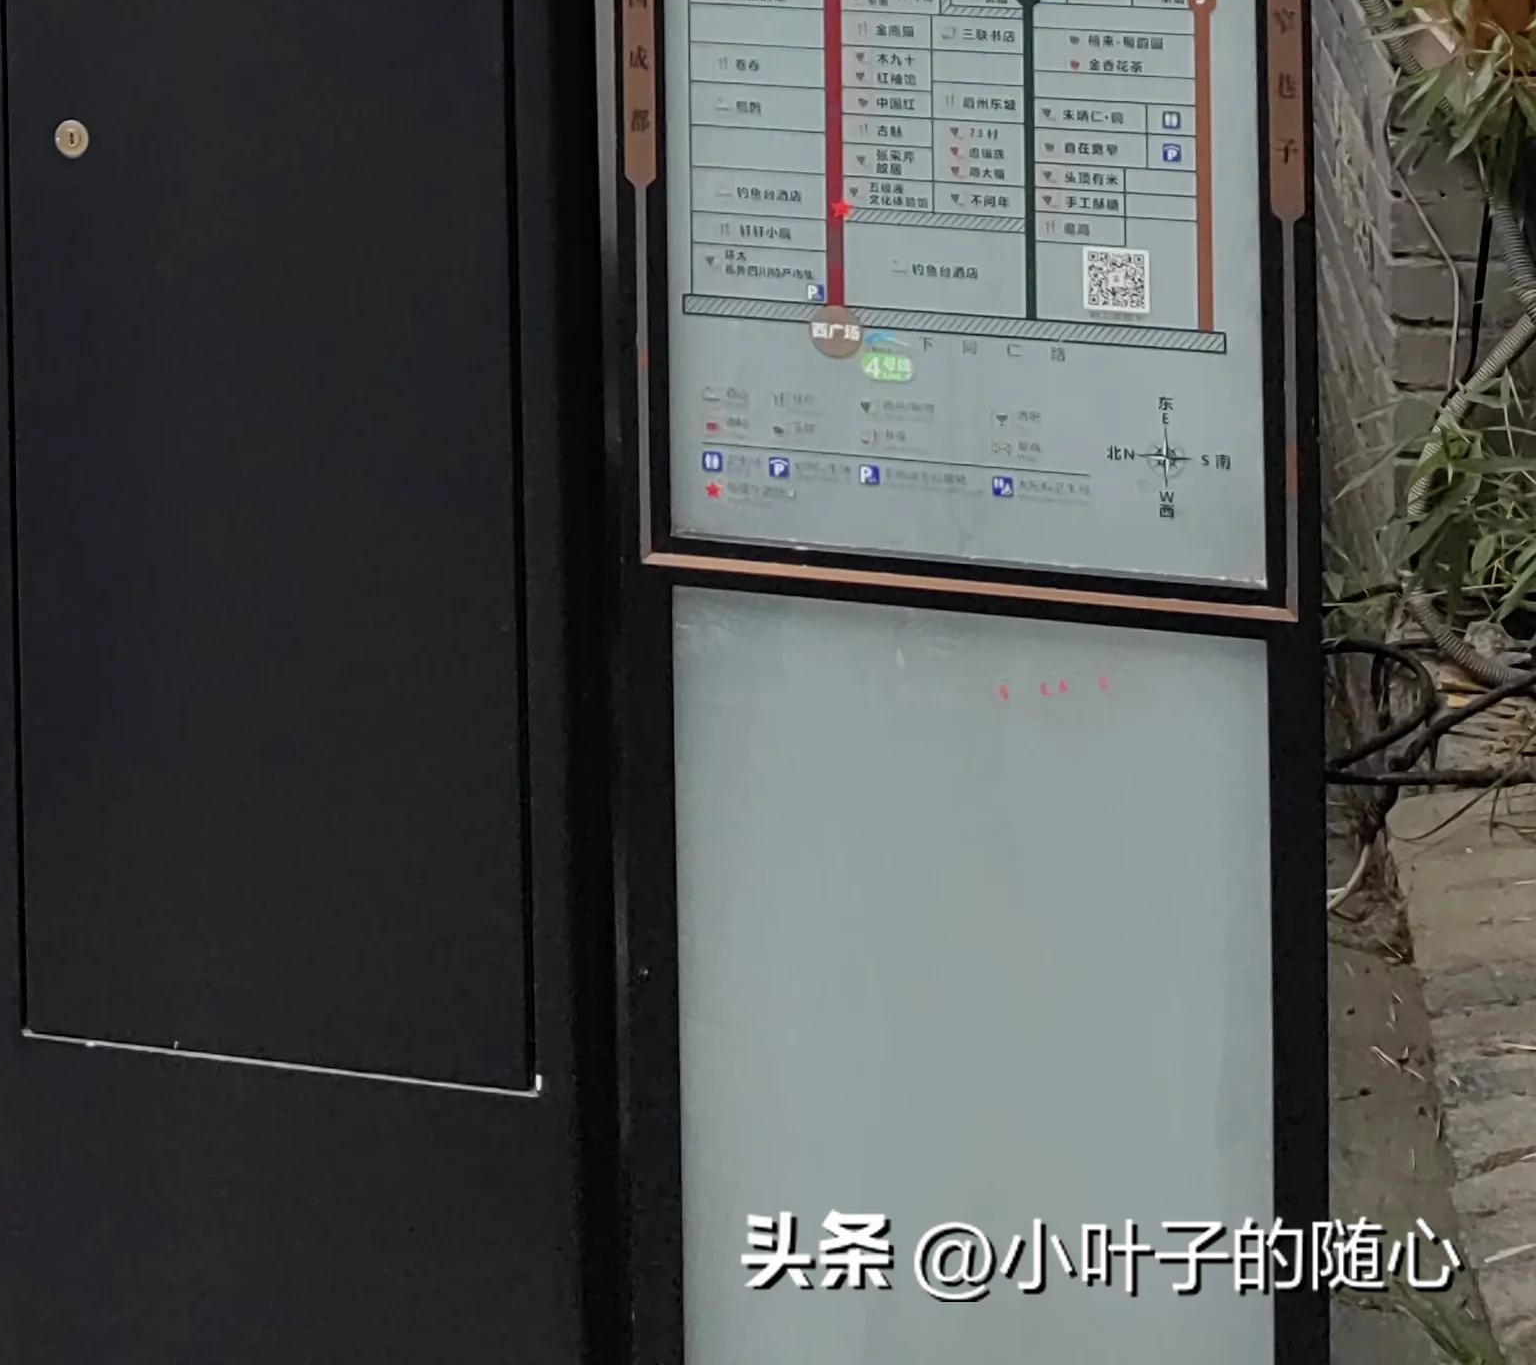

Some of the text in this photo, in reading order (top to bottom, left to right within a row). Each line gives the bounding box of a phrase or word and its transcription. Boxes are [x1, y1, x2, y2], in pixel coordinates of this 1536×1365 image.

[963, 28, 1015, 42] 三联书店
[877, 53, 915, 66] 木九十
[876, 98, 915, 110] 中国红
[737, 186, 802, 202] 钓鱼台酒店
[912, 264, 978, 279] 钓鱼台酒店
[811, 322, 859, 341] 西广场
[1159, 397, 1173, 410] 东
[1162, 413, 1169, 424] E
[1107, 446, 1121, 460] 北
[1123, 448, 1135, 460] N
[1216, 454, 1231, 469] 南
[1159, 491, 1174, 503] W
[1159, 504, 1174, 518] 西
